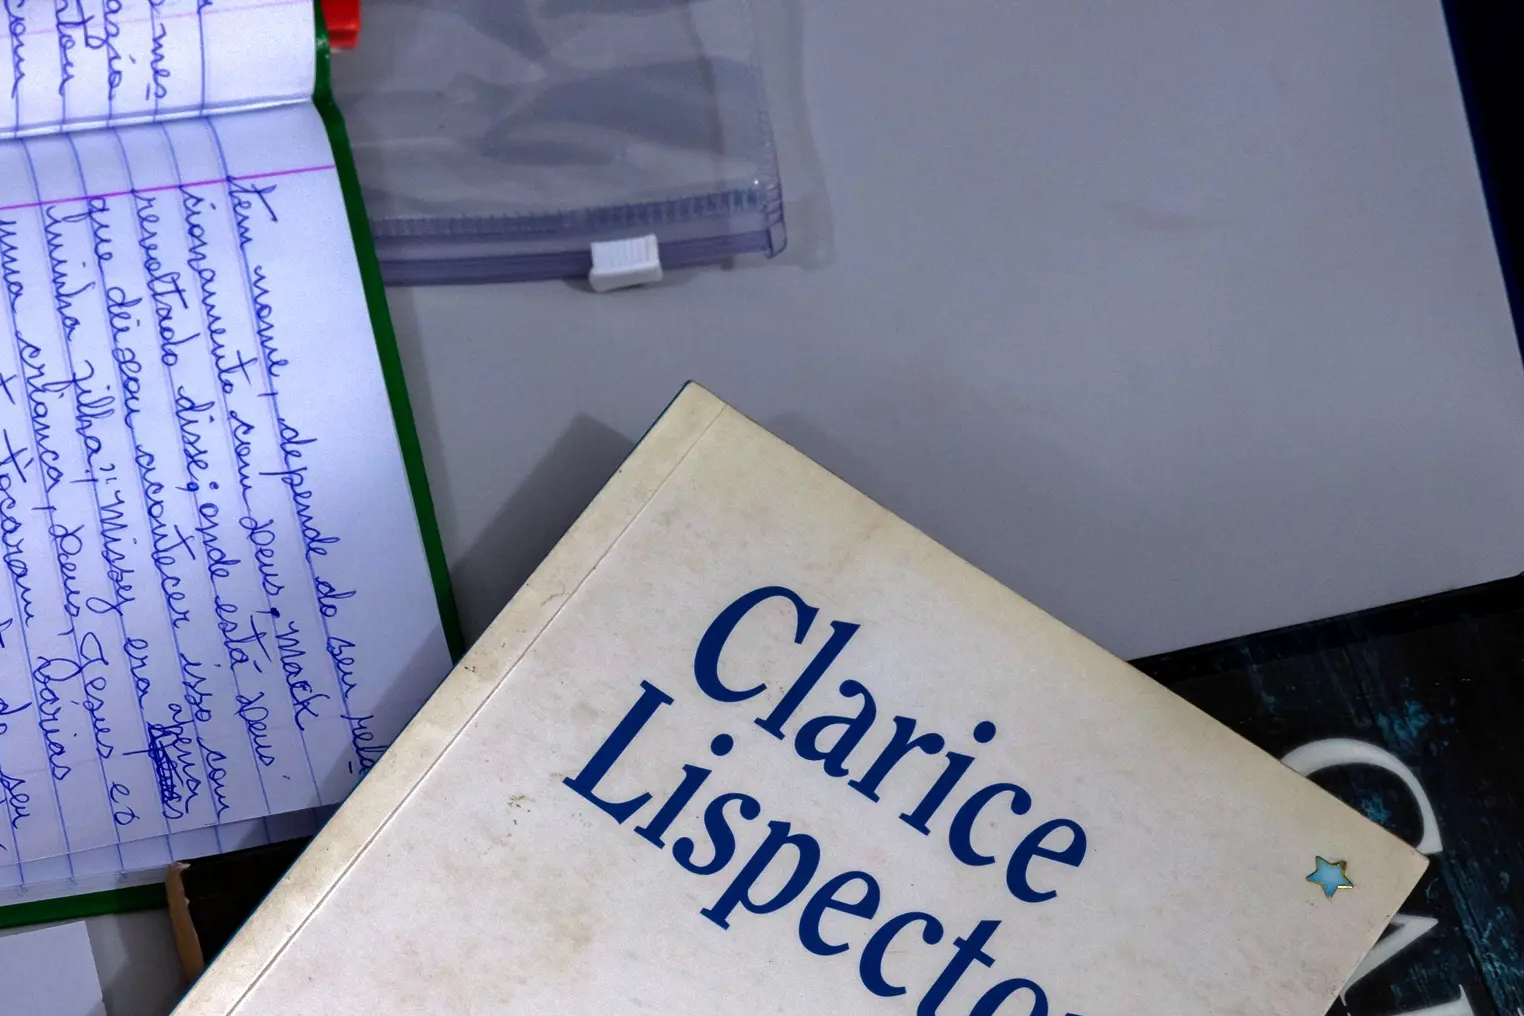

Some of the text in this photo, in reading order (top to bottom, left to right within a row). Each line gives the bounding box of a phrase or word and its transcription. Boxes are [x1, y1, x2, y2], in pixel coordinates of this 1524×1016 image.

[258, 415, 341, 565] depende
[312, 575, 357, 622] do
[694, 584, 1088, 903] Clarice
